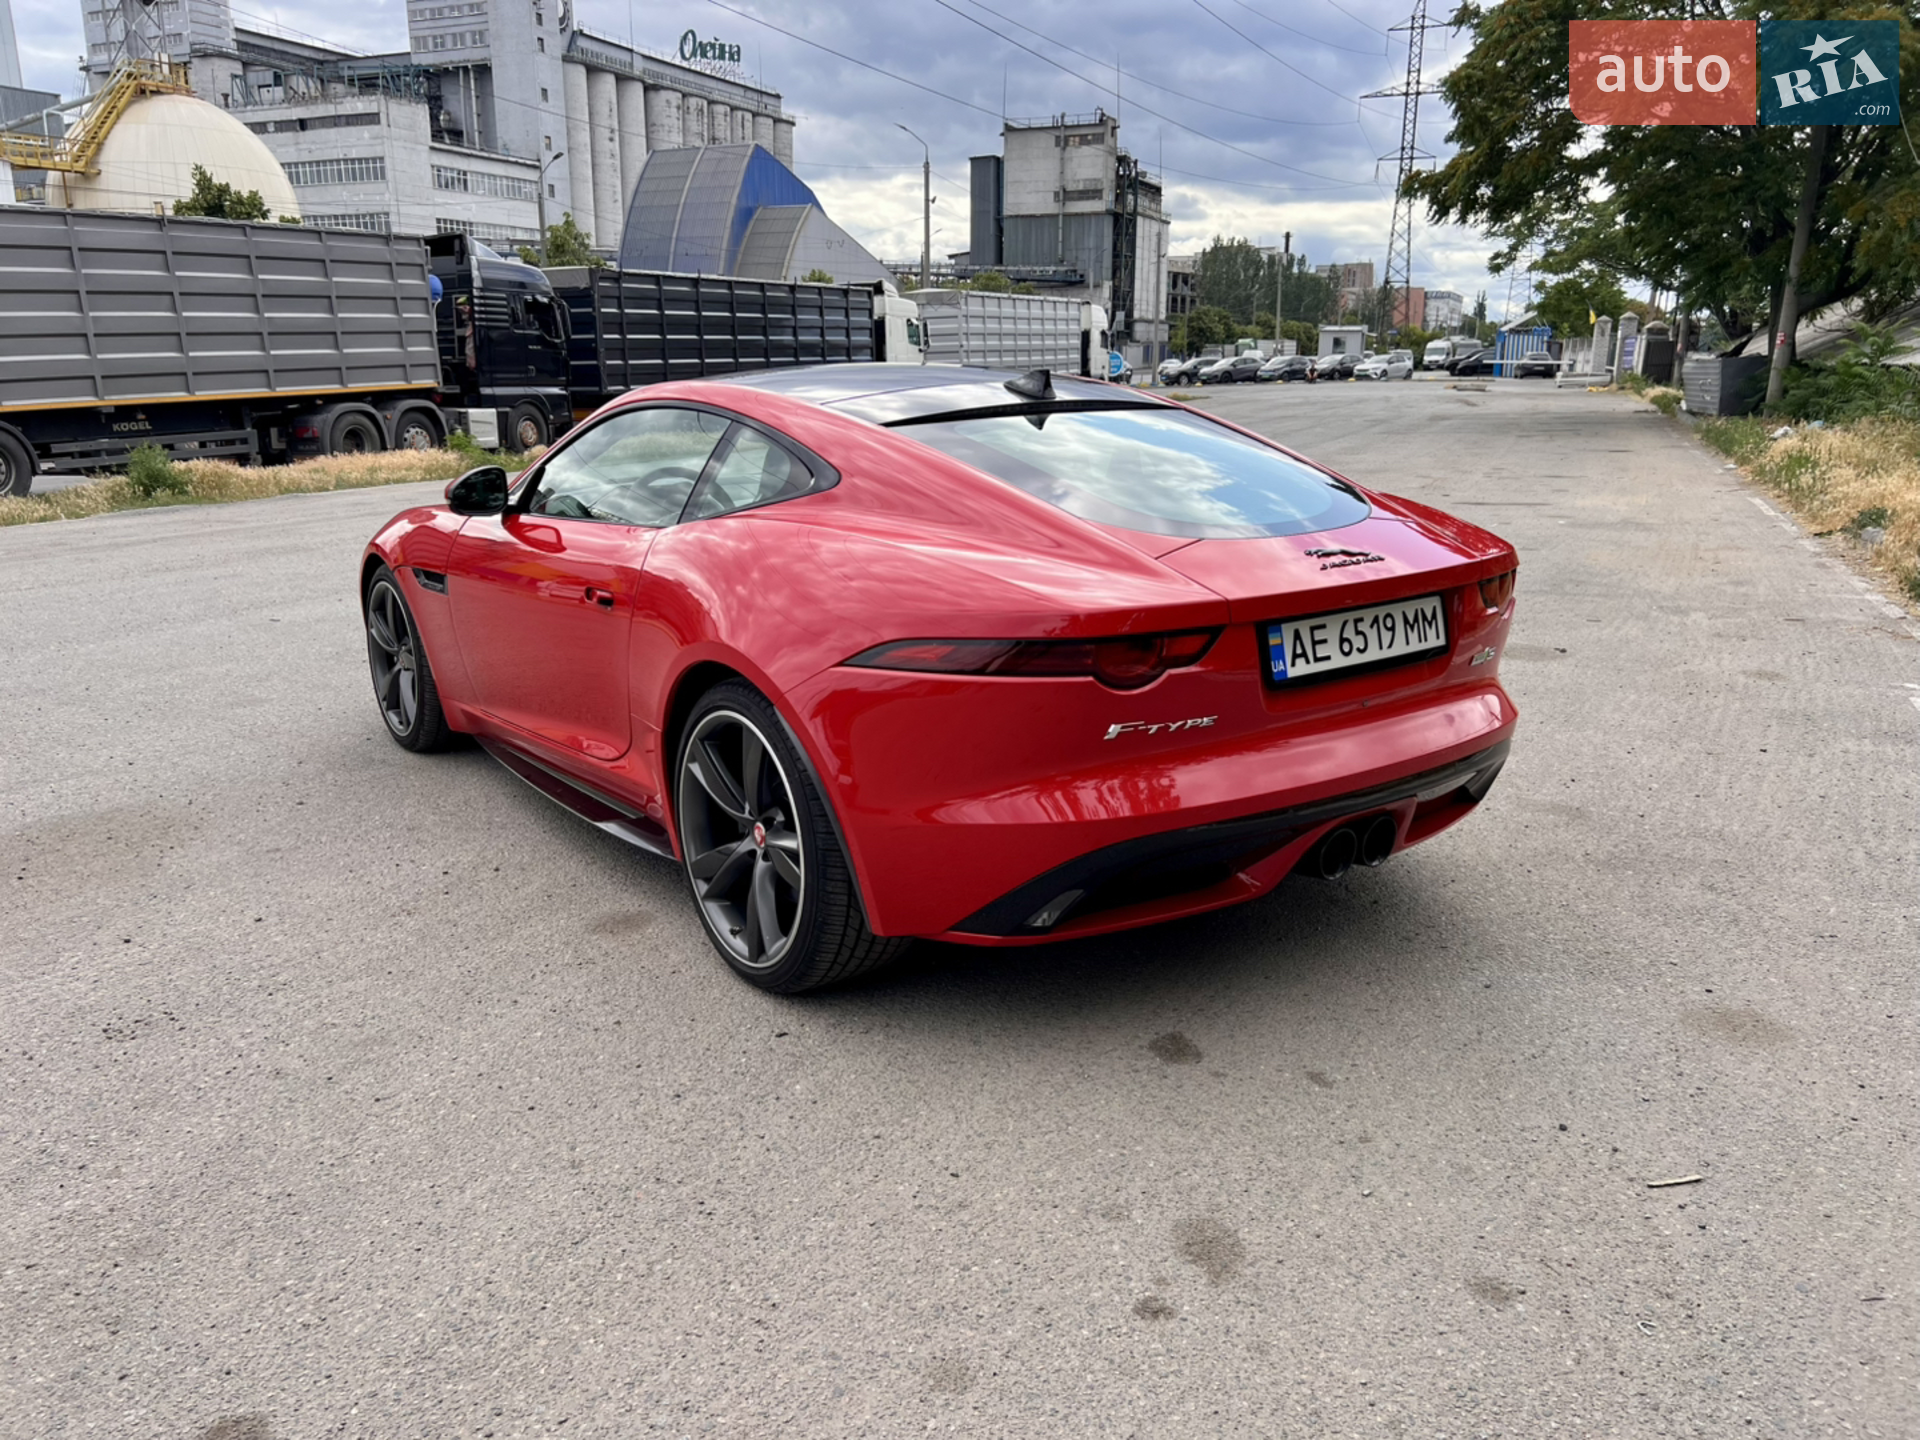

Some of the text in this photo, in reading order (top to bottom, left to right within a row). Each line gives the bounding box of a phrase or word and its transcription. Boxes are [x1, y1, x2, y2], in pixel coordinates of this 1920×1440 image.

[680, 29, 741, 62] Олейна
[1290, 605, 1441, 667] AE 6519 MM
[1271, 660, 1286, 672] UA
[1103, 715, 1218, 740] F-TYPE
